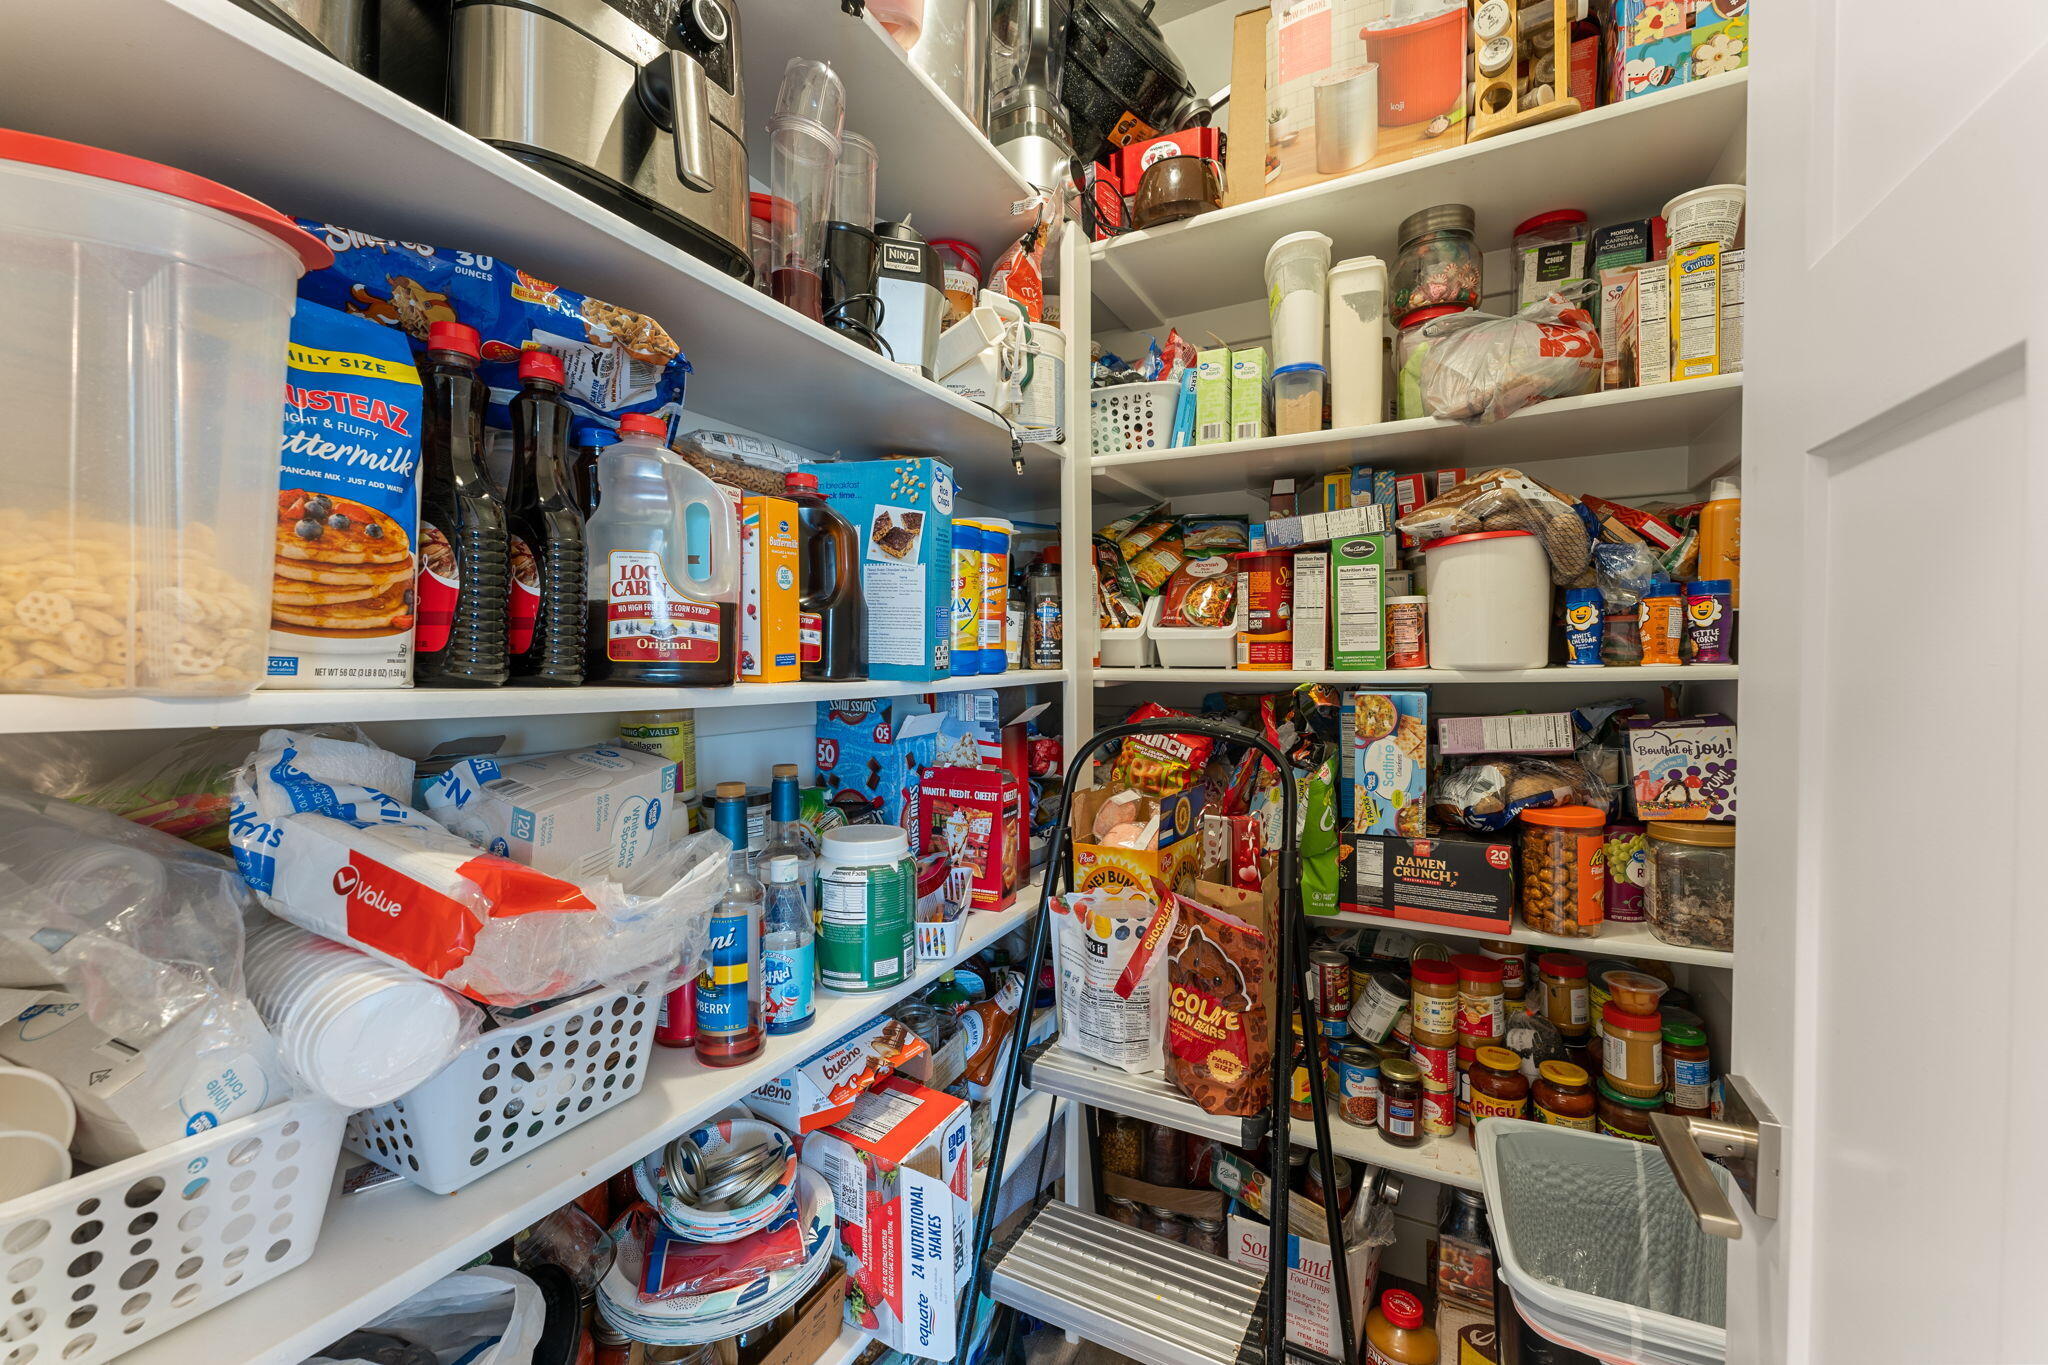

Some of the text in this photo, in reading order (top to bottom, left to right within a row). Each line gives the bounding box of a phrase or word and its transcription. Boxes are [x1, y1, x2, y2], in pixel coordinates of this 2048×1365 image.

[1390, 101, 1405, 112] koji
[1610, 228, 1635, 236] MORTON
[1600, 238, 1643, 251] PICKLING SALT
[1604, 236, 1633, 246] CANNING
[455, 250, 493, 271] 30
[888, 249, 915, 263] NINJA
[1544, 254, 1566, 265] CHEF
[454, 266, 493, 282] OUNCES
[339, 357, 388, 374] SIZE
[1189, 371, 1197, 393] CERTO
[285, 384, 410, 437] USTEAZ
[323, 418, 333, 429] &
[337, 421, 379, 441] FLUFFY
[279, 465, 385, 490] PANCAKE MIX JUST ADD
[825, 481, 860, 489] breakfast
[939, 484, 949, 497] Rice
[937, 495, 950, 508] Crisps
[620, 564, 658, 580] LOG
[618, 603, 711, 616] NO HIGH CORN SYRUP
[800, 617, 814, 625] SYRUP
[1571, 631, 1592, 640] WHITE
[1571, 636, 1598, 645] CHEDDAR
[1692, 628, 1720, 637] KETTLE
[1696, 635, 1719, 644] CORN
[636, 638, 692, 652] Original
[314, 668, 326, 676] NET
[328, 668, 339, 676] WT
[348, 668, 356, 676] OZ
[365, 668, 372, 677] LB
[649, 727, 678, 736] VALLEY
[817, 743, 835, 763] 50
[1637, 738, 1733, 760] Bowlful of joy!
[1382, 744, 1395, 788] Saltine
[665, 767, 675, 791] 120
[1703, 768, 1733, 792] YUM!
[921, 786, 939, 796] WANT
[949, 788, 964, 799] NEED
[974, 790, 1000, 802] CHEEZ-IT
[1362, 796, 1376, 817] PACKS
[516, 812, 530, 839] 120
[617, 815, 632, 869] & Spoons
[625, 804, 641, 869] White Forks
[1078, 852, 1096, 865] Post
[1160, 854, 1173, 869] Post
[1396, 855, 1447, 871] RAMEN
[1490, 849, 1509, 861] 20
[1392, 866, 1451, 883] CRUNCH
[356, 880, 402, 918] Value
[1144, 897, 1174, 951] CHOCOLATE
[697, 1000, 732, 1015] BERRY
[1194, 1021, 1227, 1041] BEARS
[822, 1046, 861, 1080] bueno
[826, 1048, 847, 1063] Kinder
[1212, 1055, 1239, 1069] PARTY
[1214, 1062, 1234, 1075] SIZE
[221, 1068, 247, 1101] Forks
[206, 1079, 232, 1114] White
[1474, 1102, 1517, 1118] RAGÚ
[910, 1185, 925, 1280] 24 NUTRITIONAL
[927, 1214, 942, 1261] SHAKES
[1289, 1272, 1331, 1294] Food Trays
[1301, 1292, 1330, 1308] Food Tray
[919, 1293, 929, 1347] equate
[1317, 1313, 1330, 1322] Tray
